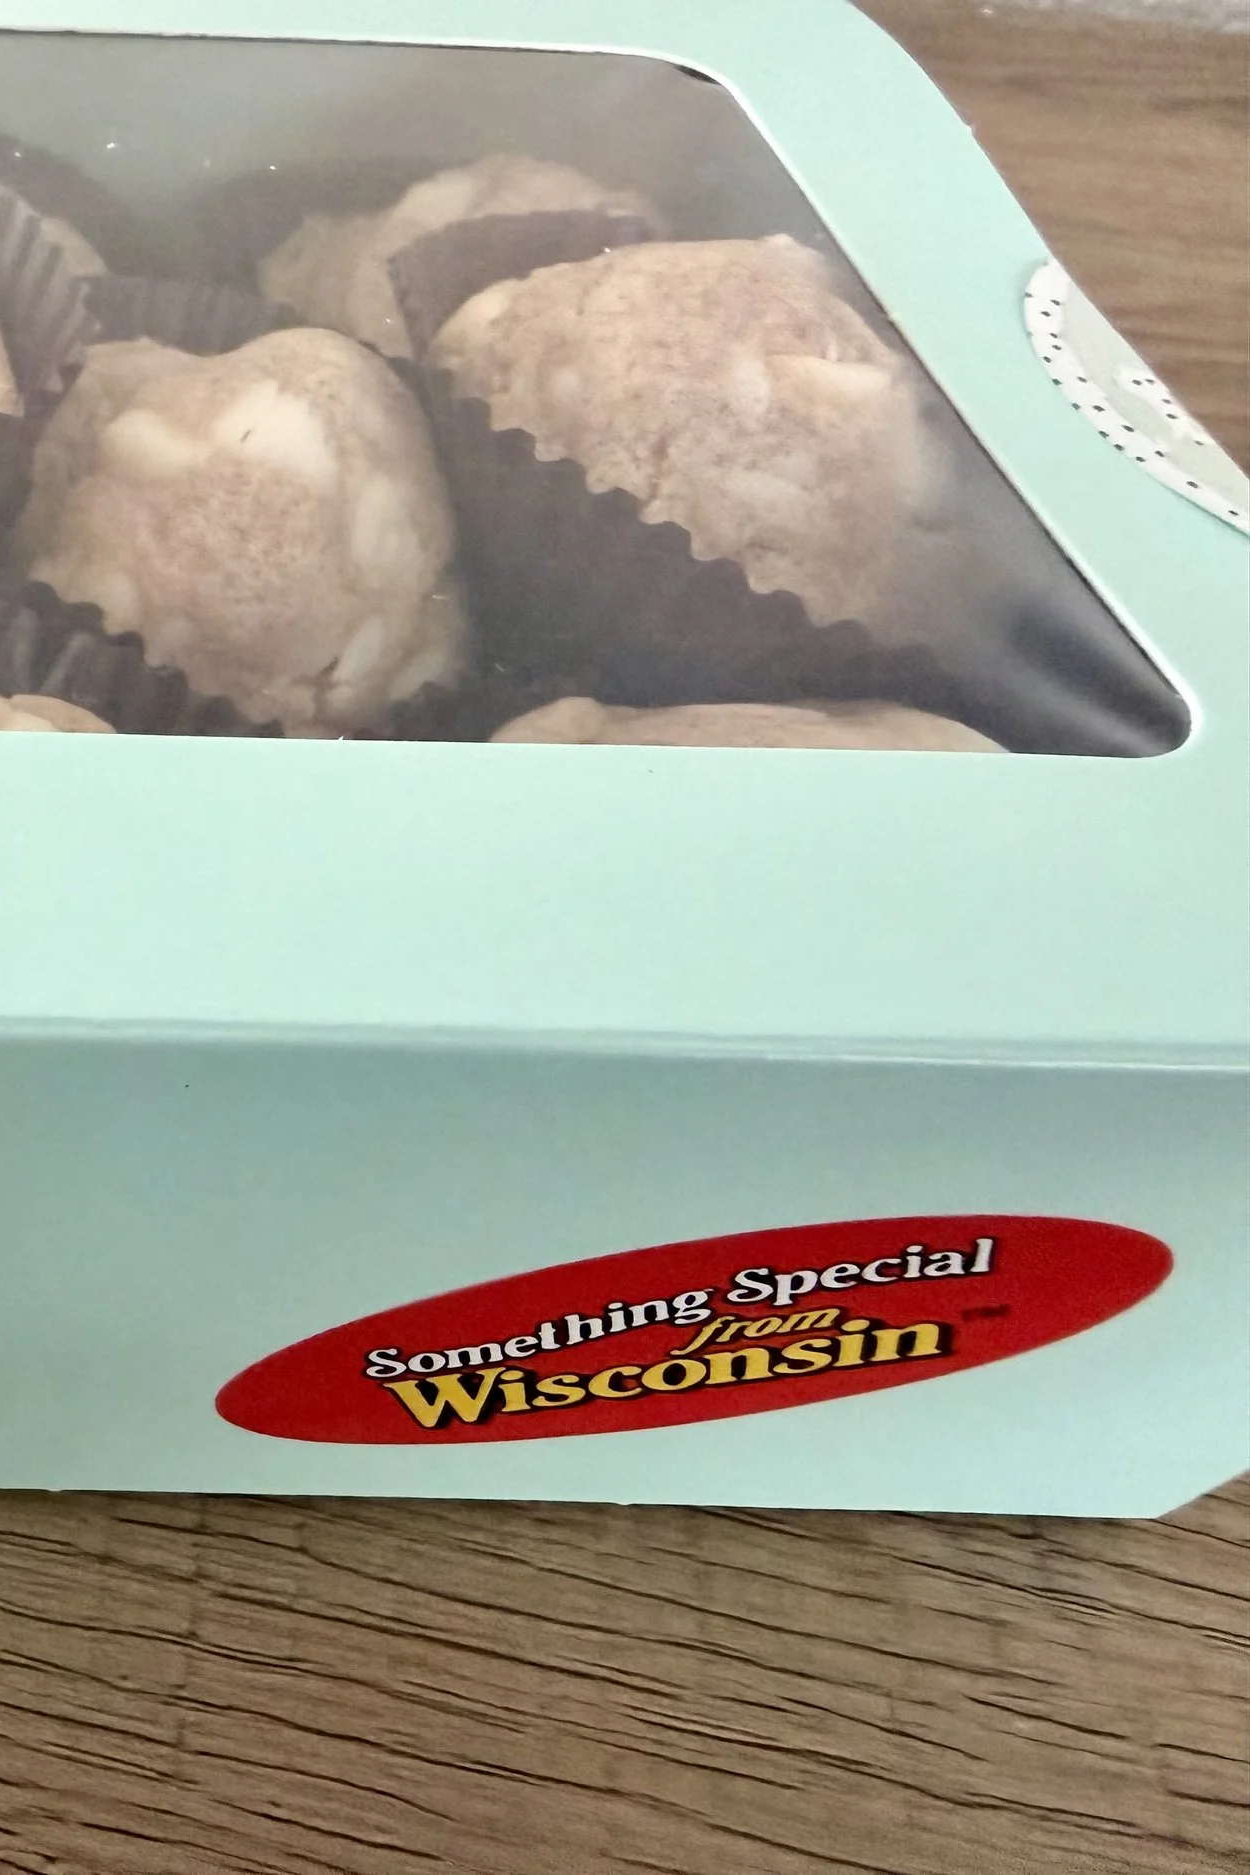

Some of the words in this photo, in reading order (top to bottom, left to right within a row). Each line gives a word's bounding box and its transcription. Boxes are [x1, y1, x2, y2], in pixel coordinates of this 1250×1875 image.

[365, 1287, 714, 1378] Something
[726, 1237, 994, 1306] Special
[670, 1307, 841, 1356] from
[383, 1319, 943, 1429] Wisconsin
